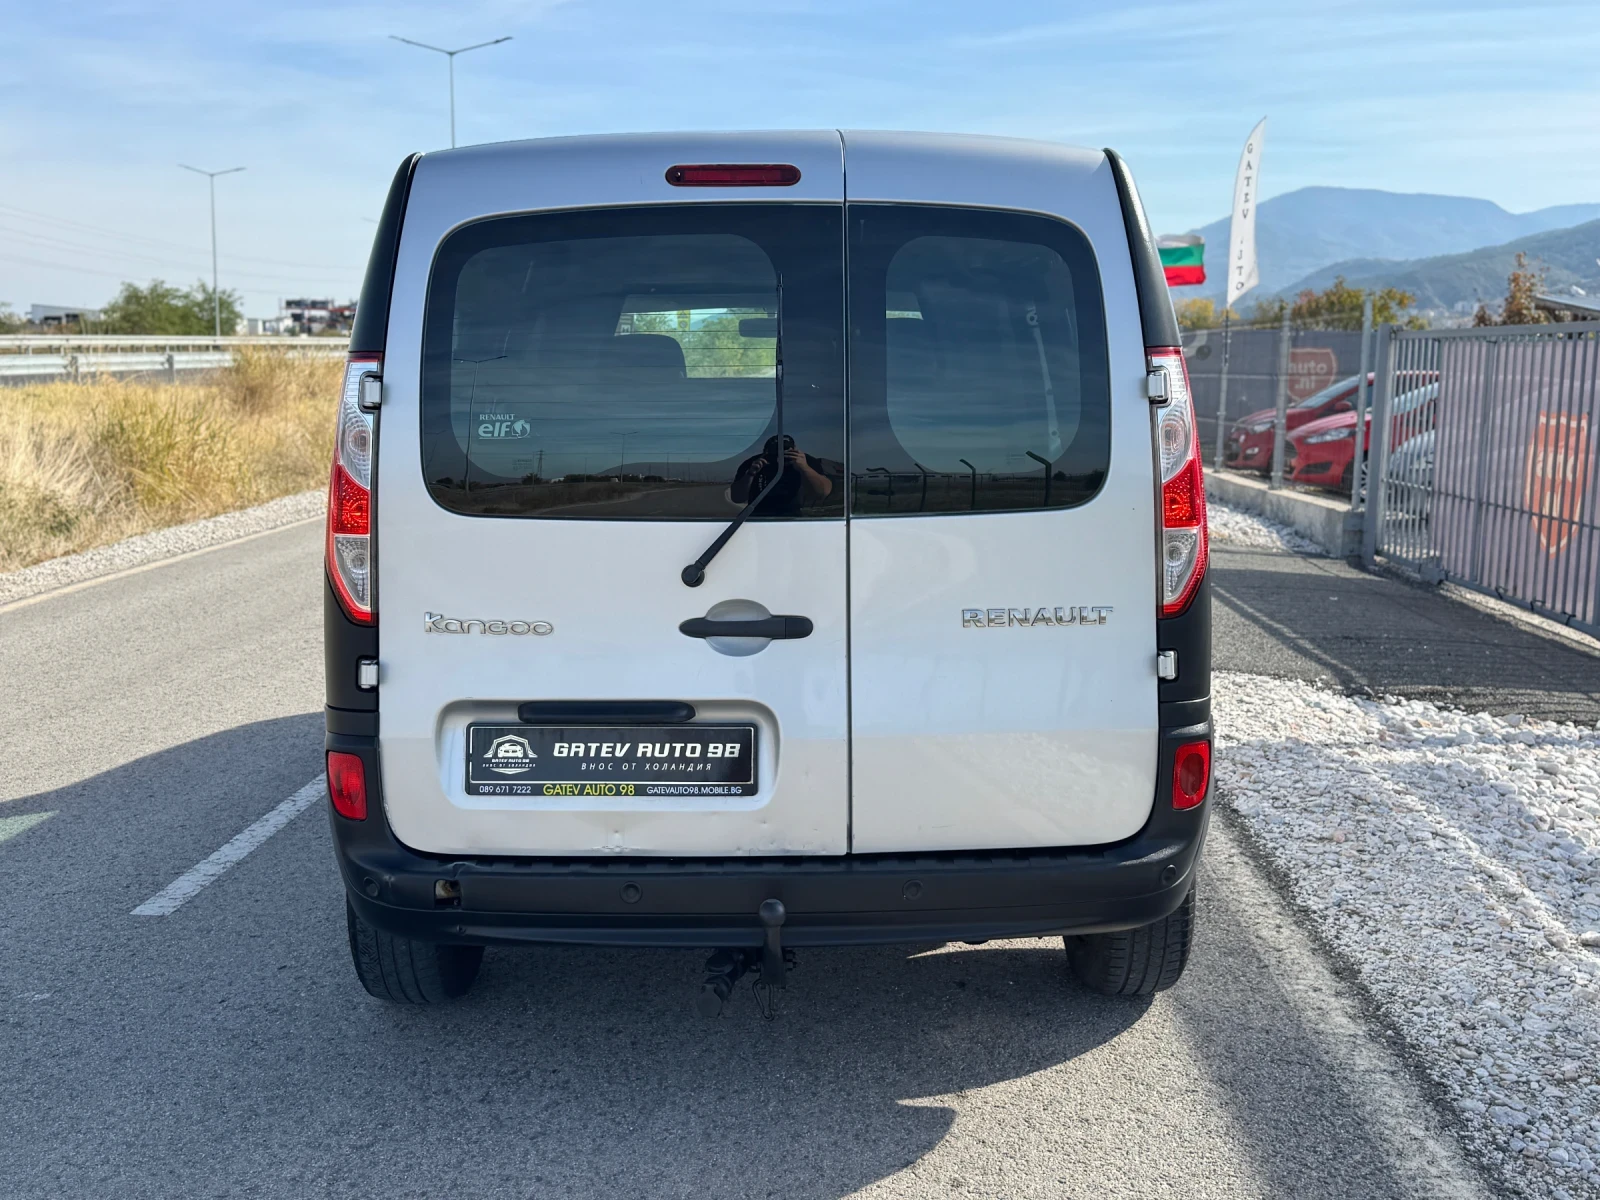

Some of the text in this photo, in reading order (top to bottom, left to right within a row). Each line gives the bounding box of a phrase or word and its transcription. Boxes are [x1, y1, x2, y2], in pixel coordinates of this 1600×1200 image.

[1241, 142, 1253, 219] GATEV
[480, 413, 516, 421] RENAULT
[478, 421, 512, 437] elf
[961, 606, 1114, 628] RENAULT
[553, 742, 741, 758] GATEV AUTO 98
[581, 762, 712, 772] ВНОС ОТ ХОЛАНДИЯ
[479, 785, 532, 794] 089 671 7222
[543, 784, 635, 796] GATEV AUTO 98
[646, 786, 742, 795] GATEVAUTO98.MOBILE.BG
